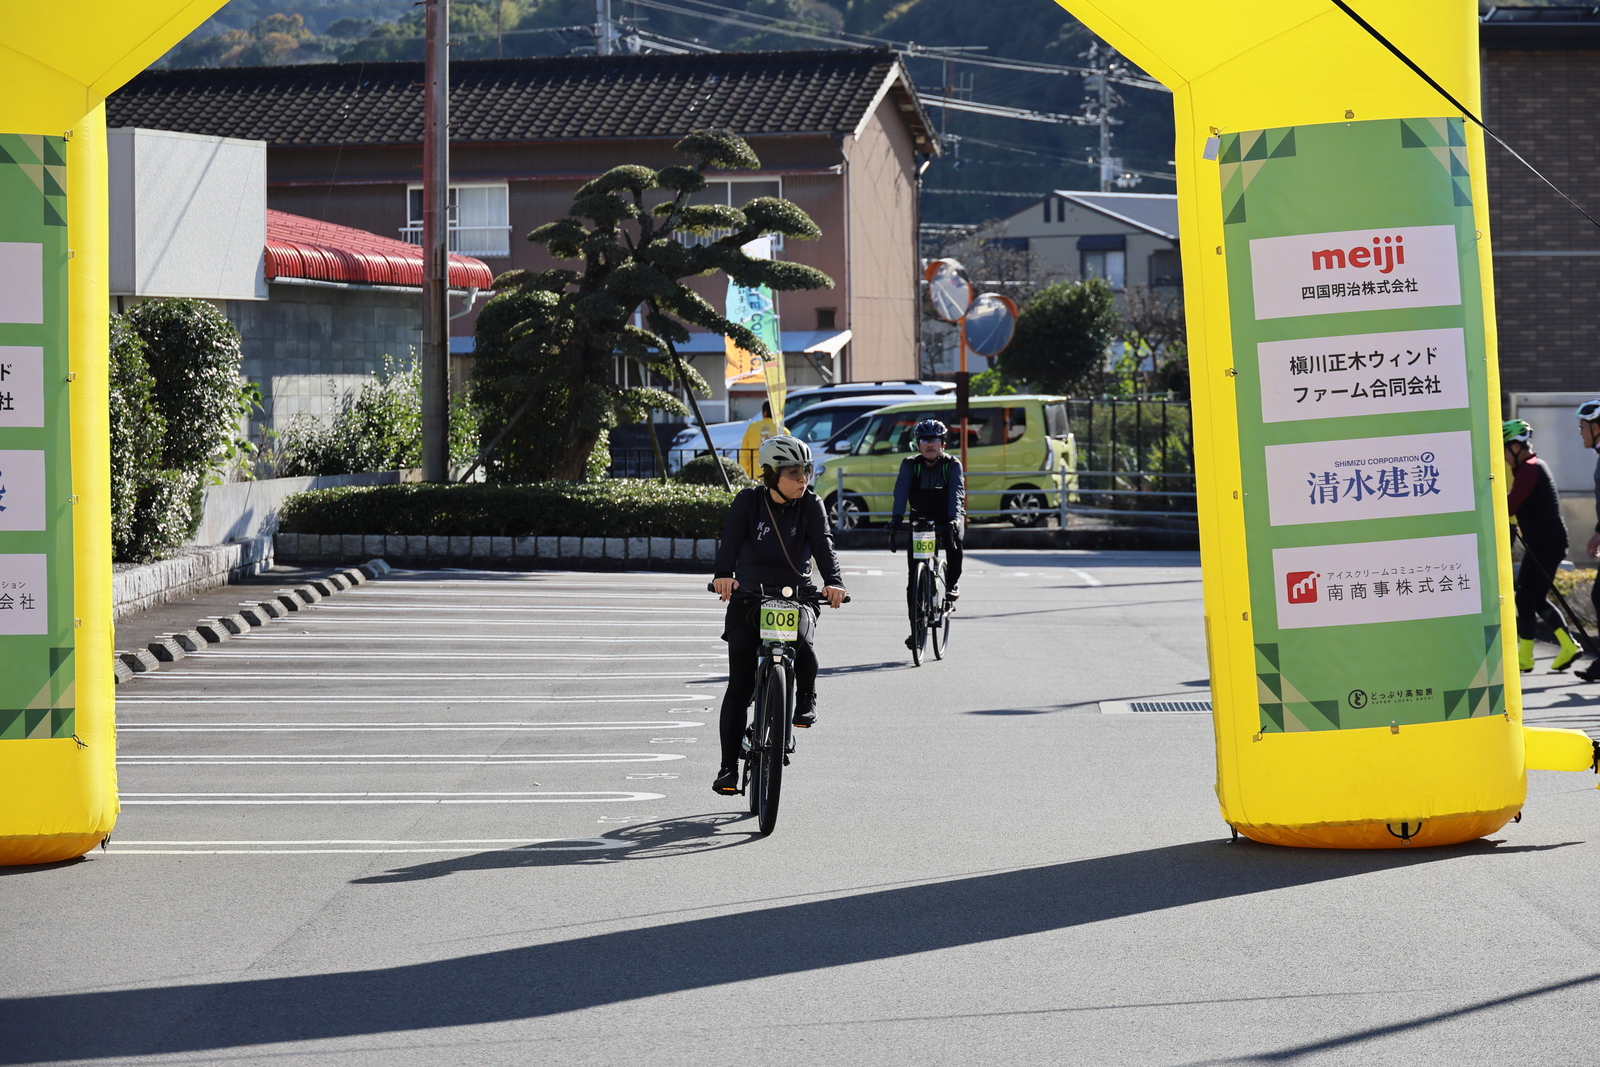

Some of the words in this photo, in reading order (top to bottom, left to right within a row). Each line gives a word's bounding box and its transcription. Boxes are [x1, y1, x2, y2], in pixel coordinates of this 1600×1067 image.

[1312, 235, 1405, 274] meiji
[1301, 278, 1418, 300] 四国明治株式会社
[1289, 347, 1438, 376] 槇川正木ウィンド
[1, 363, 12, 381] ド
[1293, 374, 1442, 404] ファーム合同会社
[1334, 459, 1366, 468] SHIMIZU
[1367, 455, 1420, 465] CORPORATION
[1307, 464, 1441, 506] 清水建設
[916, 541, 934, 551] 050
[1327, 562, 1462, 581] アイスクリームコミュニケーション
[1327, 573, 1471, 602] 南商事株式会社
[0, 593, 35, 610] 会社
[766, 611, 795, 627] 008
[1371, 688, 1433, 701] どっぷり高知旅
